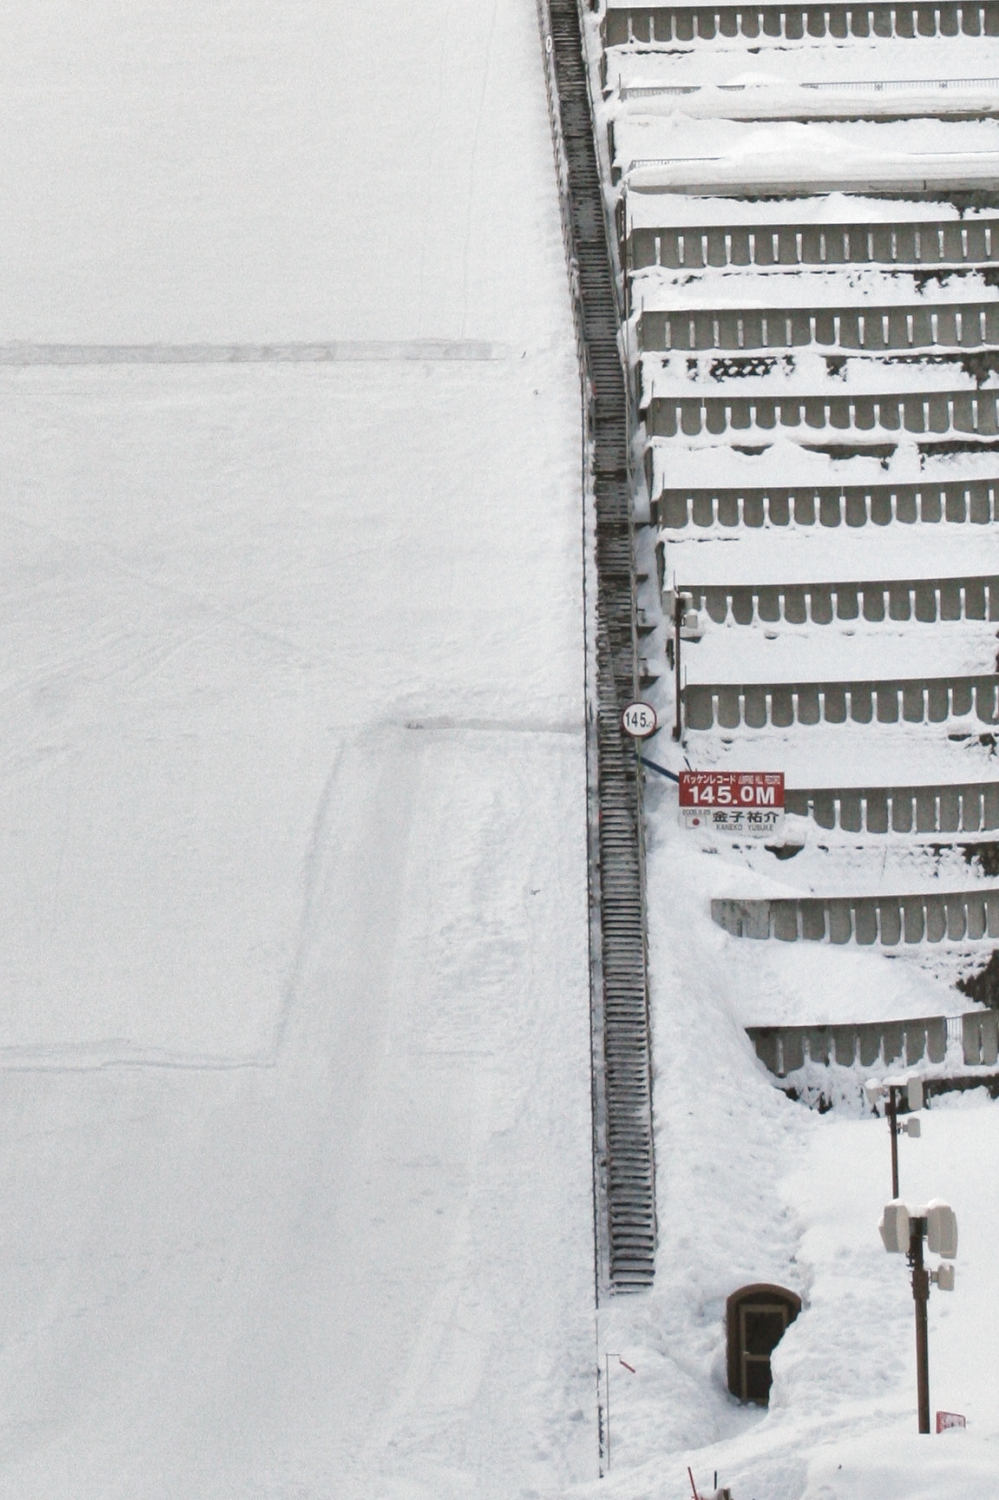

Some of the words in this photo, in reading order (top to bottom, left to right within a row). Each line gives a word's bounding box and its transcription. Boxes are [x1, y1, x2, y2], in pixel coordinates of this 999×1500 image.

[682, 774, 737, 785] バッケンレコード
[688, 785, 775, 805] 145.0M
[712, 810, 780, 824] 金子祐介
[715, 823, 743, 831] KANEKO
[747, 823, 774, 831] YUSUKE
